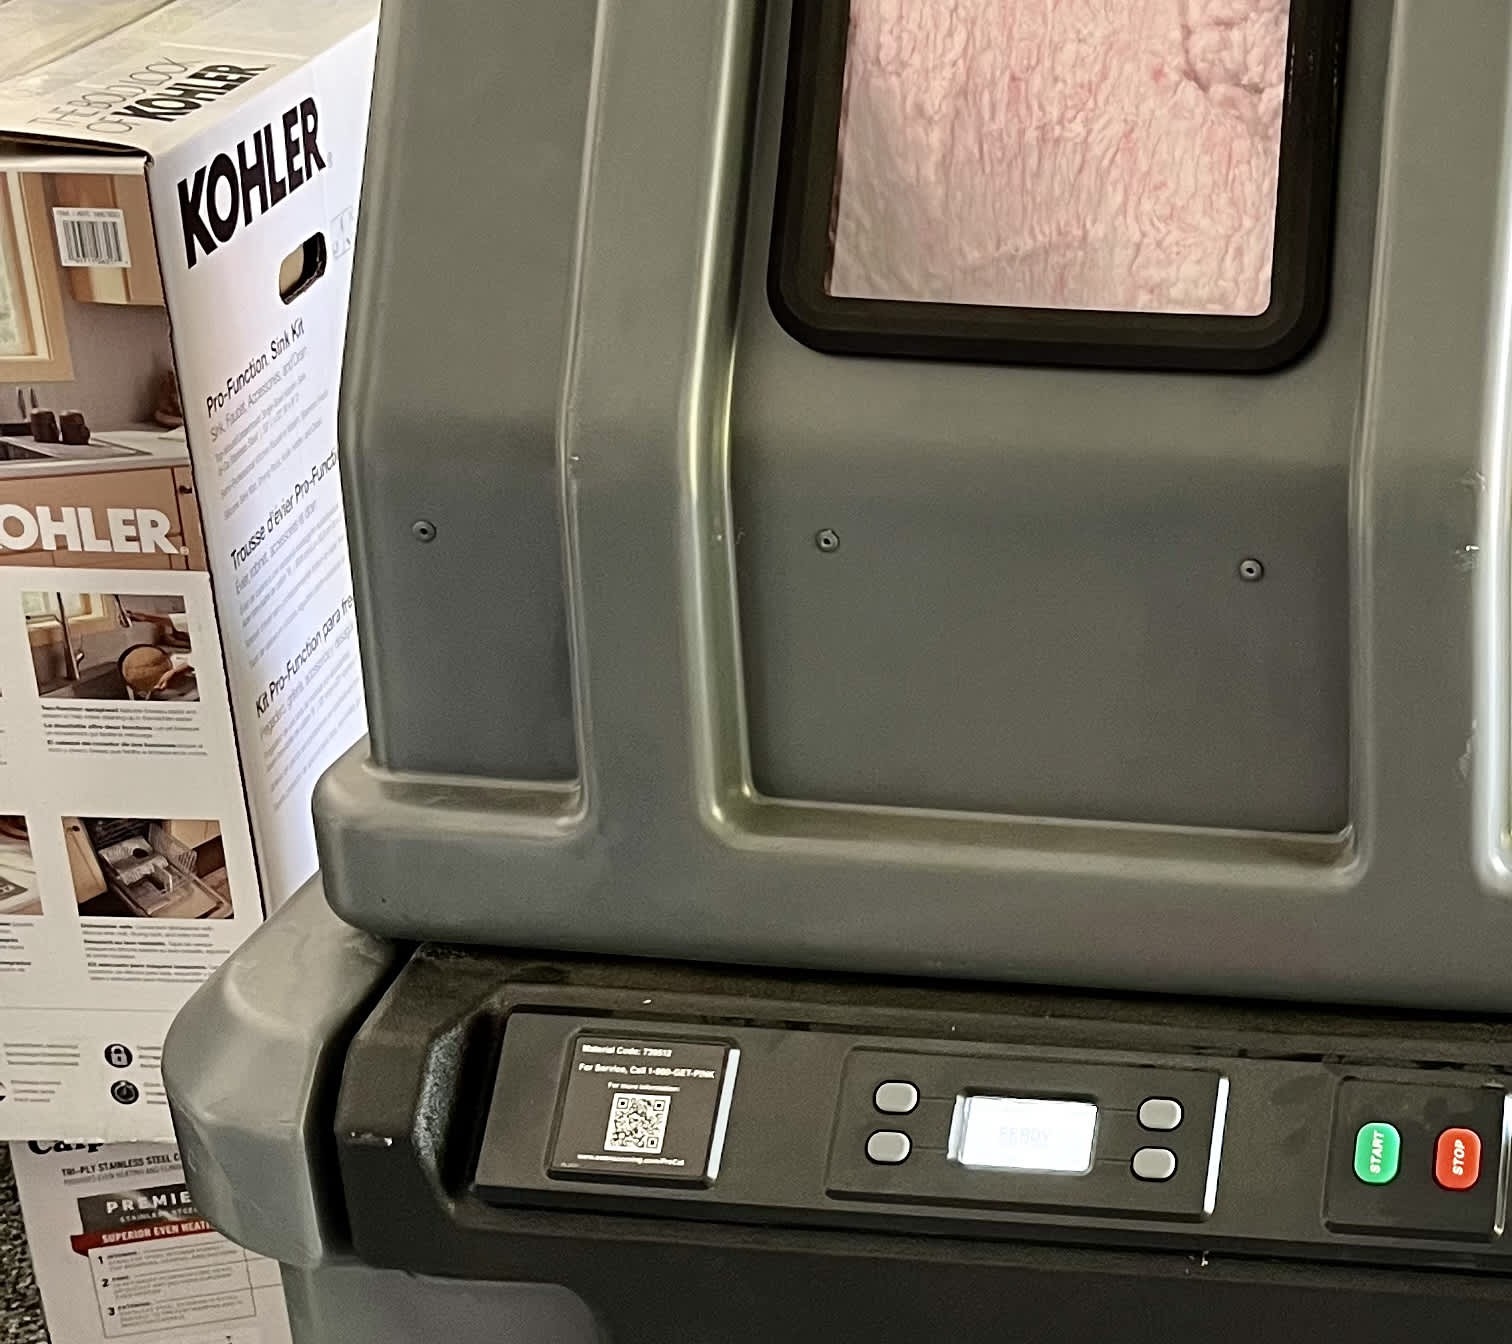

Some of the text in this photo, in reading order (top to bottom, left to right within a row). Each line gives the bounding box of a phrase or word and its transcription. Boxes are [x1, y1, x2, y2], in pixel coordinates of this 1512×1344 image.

[112, 64, 270, 123] KOHLER
[177, 96, 327, 270] KOHLER
[270, 330, 291, 361] Sink
[291, 317, 305, 343] Kit
[0, 503, 181, 554] OHLER
[230, 525, 266, 571] Trousse
[256, 690, 270, 719] Kit
[321, 607, 342, 640] para
[98, 1157, 145, 1172] STAINLESS
[1369, 1129, 1385, 1175] START
[1452, 1138, 1466, 1176] STOP
[102, 1228, 152, 1244] SUPERIOR
[153, 1224, 179, 1236] EVEN
[98, 1256, 103, 1264] 1
[102, 1278, 109, 1287] 2
[108, 1307, 115, 1316] 3
